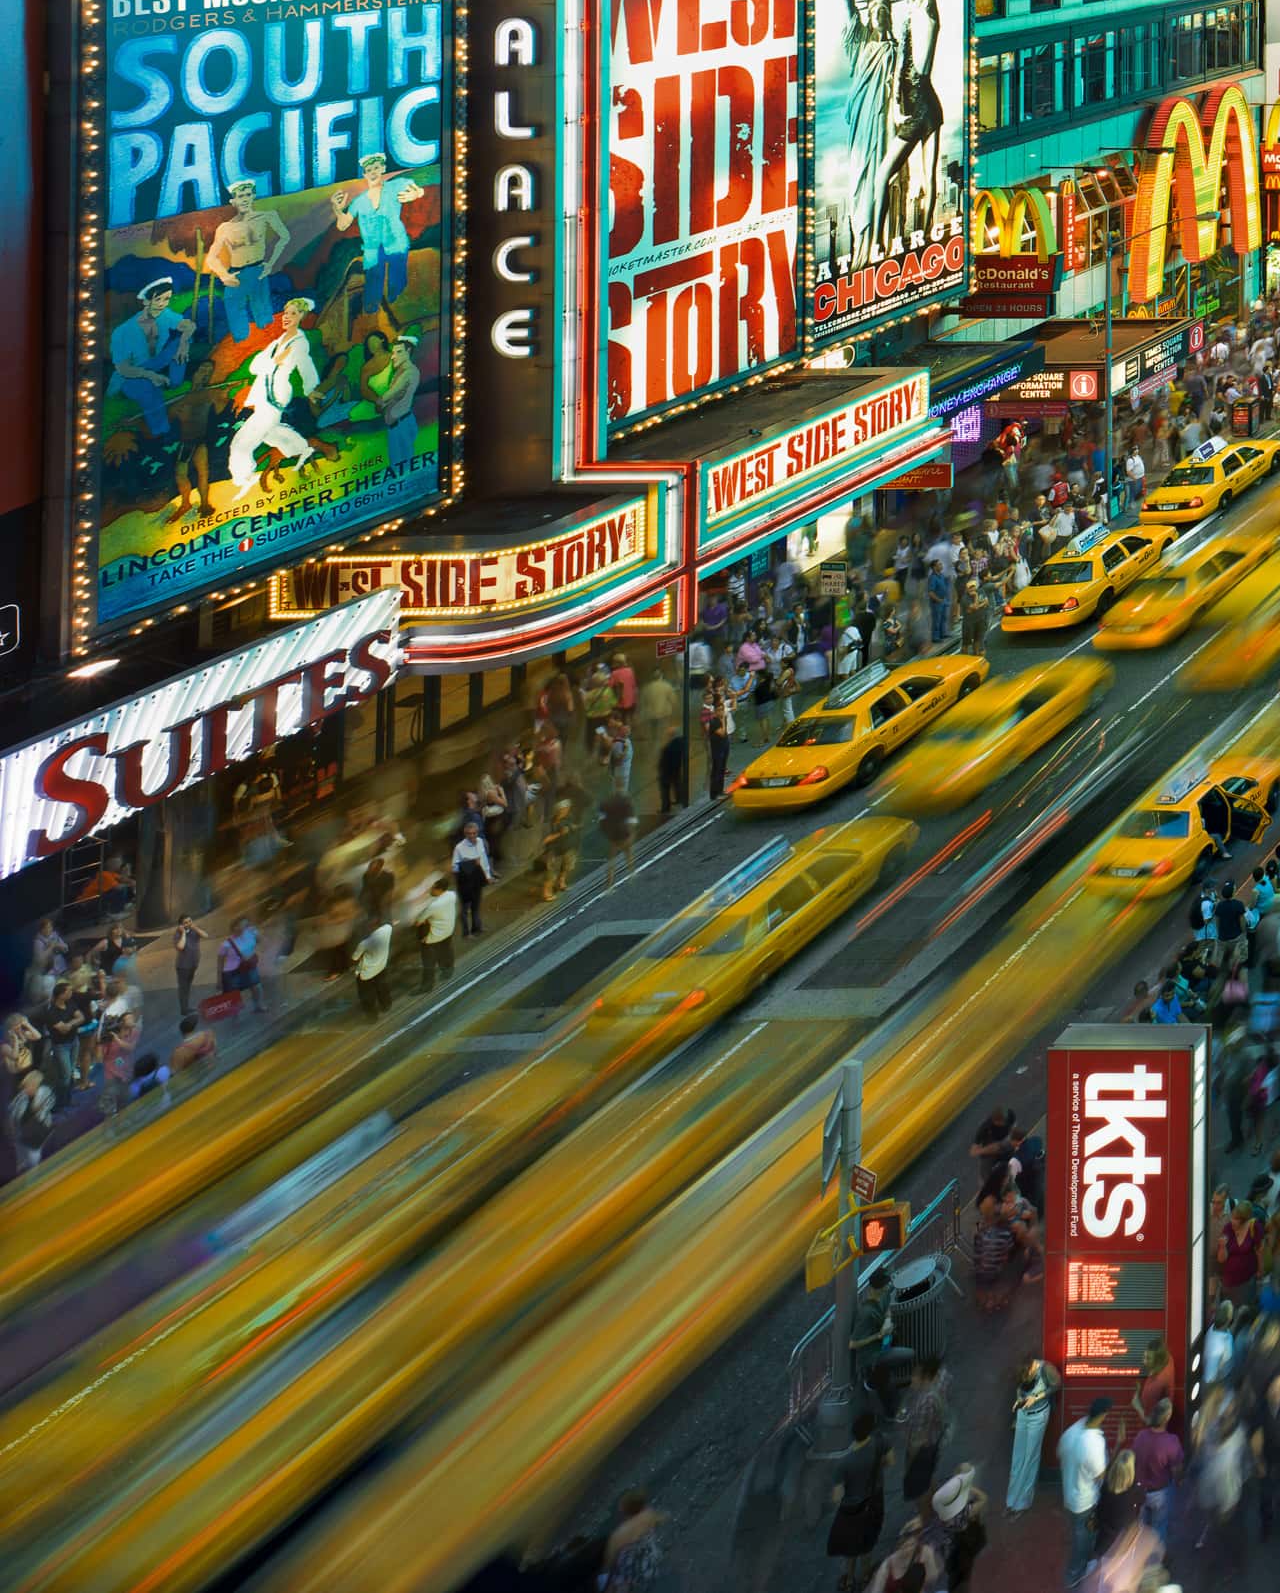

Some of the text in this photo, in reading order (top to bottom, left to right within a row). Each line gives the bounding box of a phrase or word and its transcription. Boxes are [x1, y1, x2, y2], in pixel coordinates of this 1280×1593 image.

[110, 3, 442, 129] SOUTH
[112, 9, 236, 37] RODGERS
[107, 85, 440, 228] PACIFIC
[813, 235, 965, 323] CHICAGO
[871, 216, 963, 264] LARGE
[711, 441, 783, 506] WEST
[786, 416, 847, 475] SIDE
[853, 382, 922, 448] STORY
[101, 451, 437, 588] LINCOLN CENTER THEATER
[179, 467, 349, 536] DIRECTED BARTLETT
[256, 511, 326, 547] SUBWAY
[401, 558, 497, 610] SIDE
[515, 515, 622, 600] STORY
[25, 629, 394, 856] SUITES
[1082, 1063, 1168, 1242] tkts
